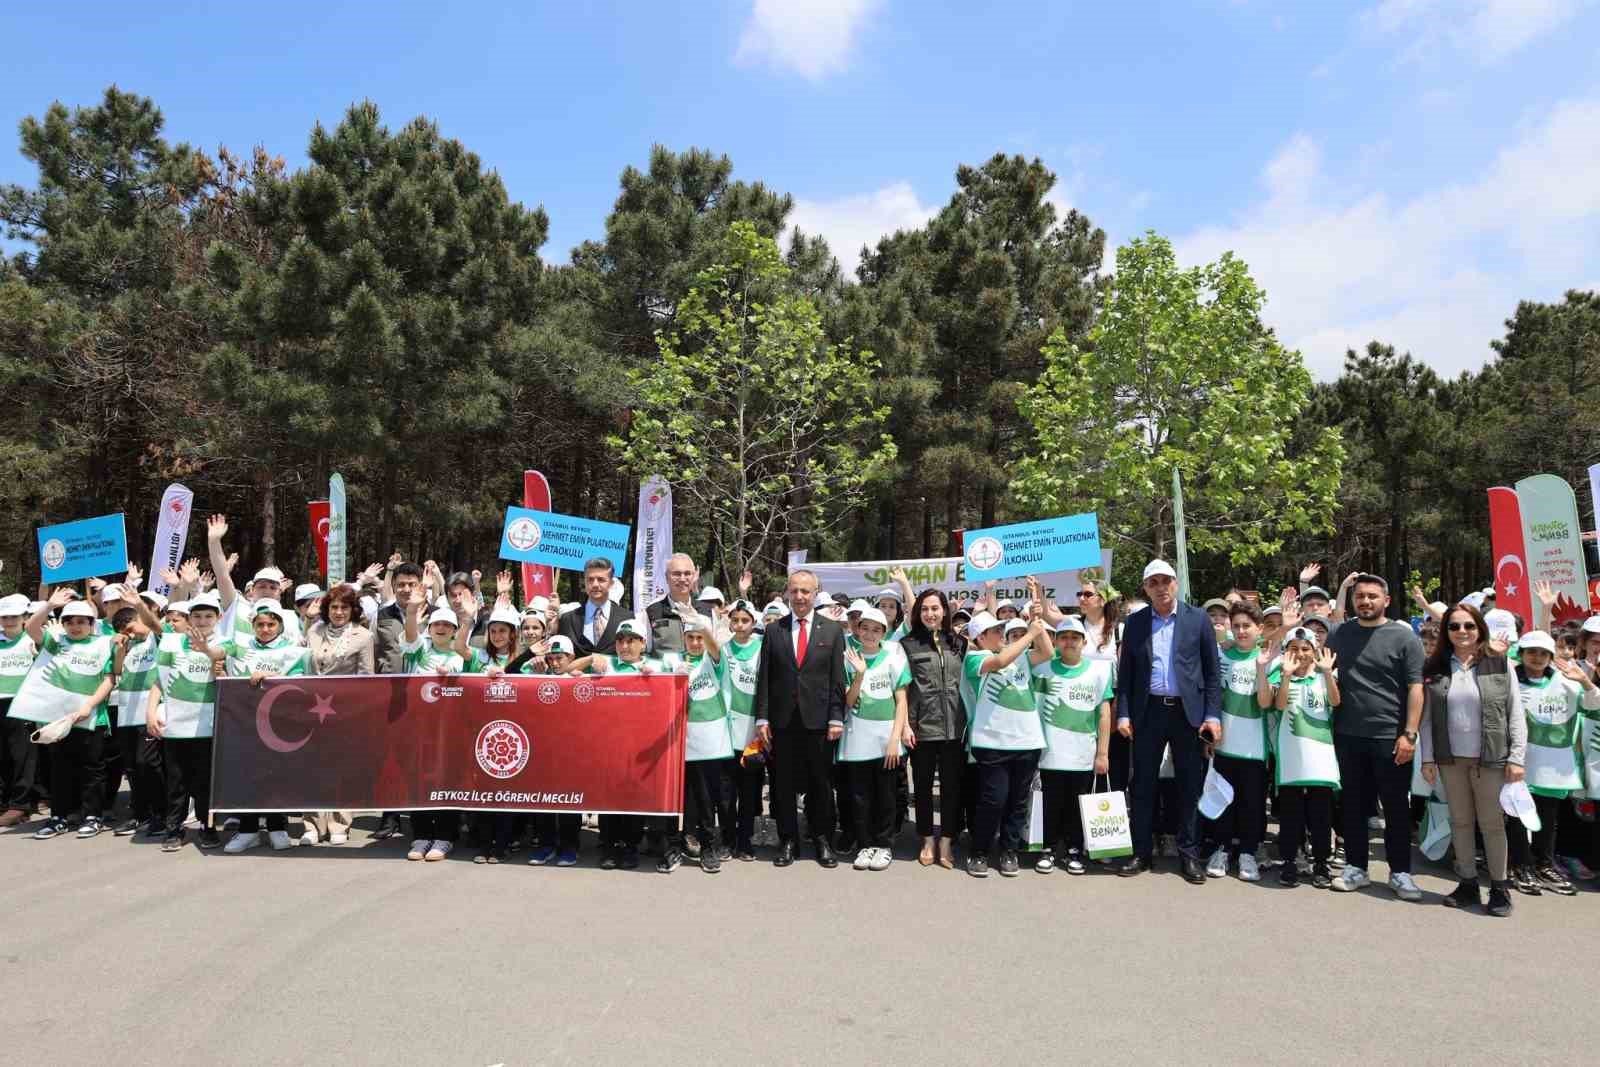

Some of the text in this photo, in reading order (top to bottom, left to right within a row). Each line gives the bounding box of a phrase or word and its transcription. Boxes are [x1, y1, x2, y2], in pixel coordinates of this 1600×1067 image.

[542, 530, 625, 551] MEHMET EMİN PULATKONAK
[1003, 531, 1096, 552] MEHMET EMİN PULATKONAK
[539, 544, 584, 558] ORTAOKULU
[1004, 551, 1044, 566] İLKOKULU
[430, 790, 584, 804] BEYKOZ İLÇE ÖĞRENCİ MECLİSİ
